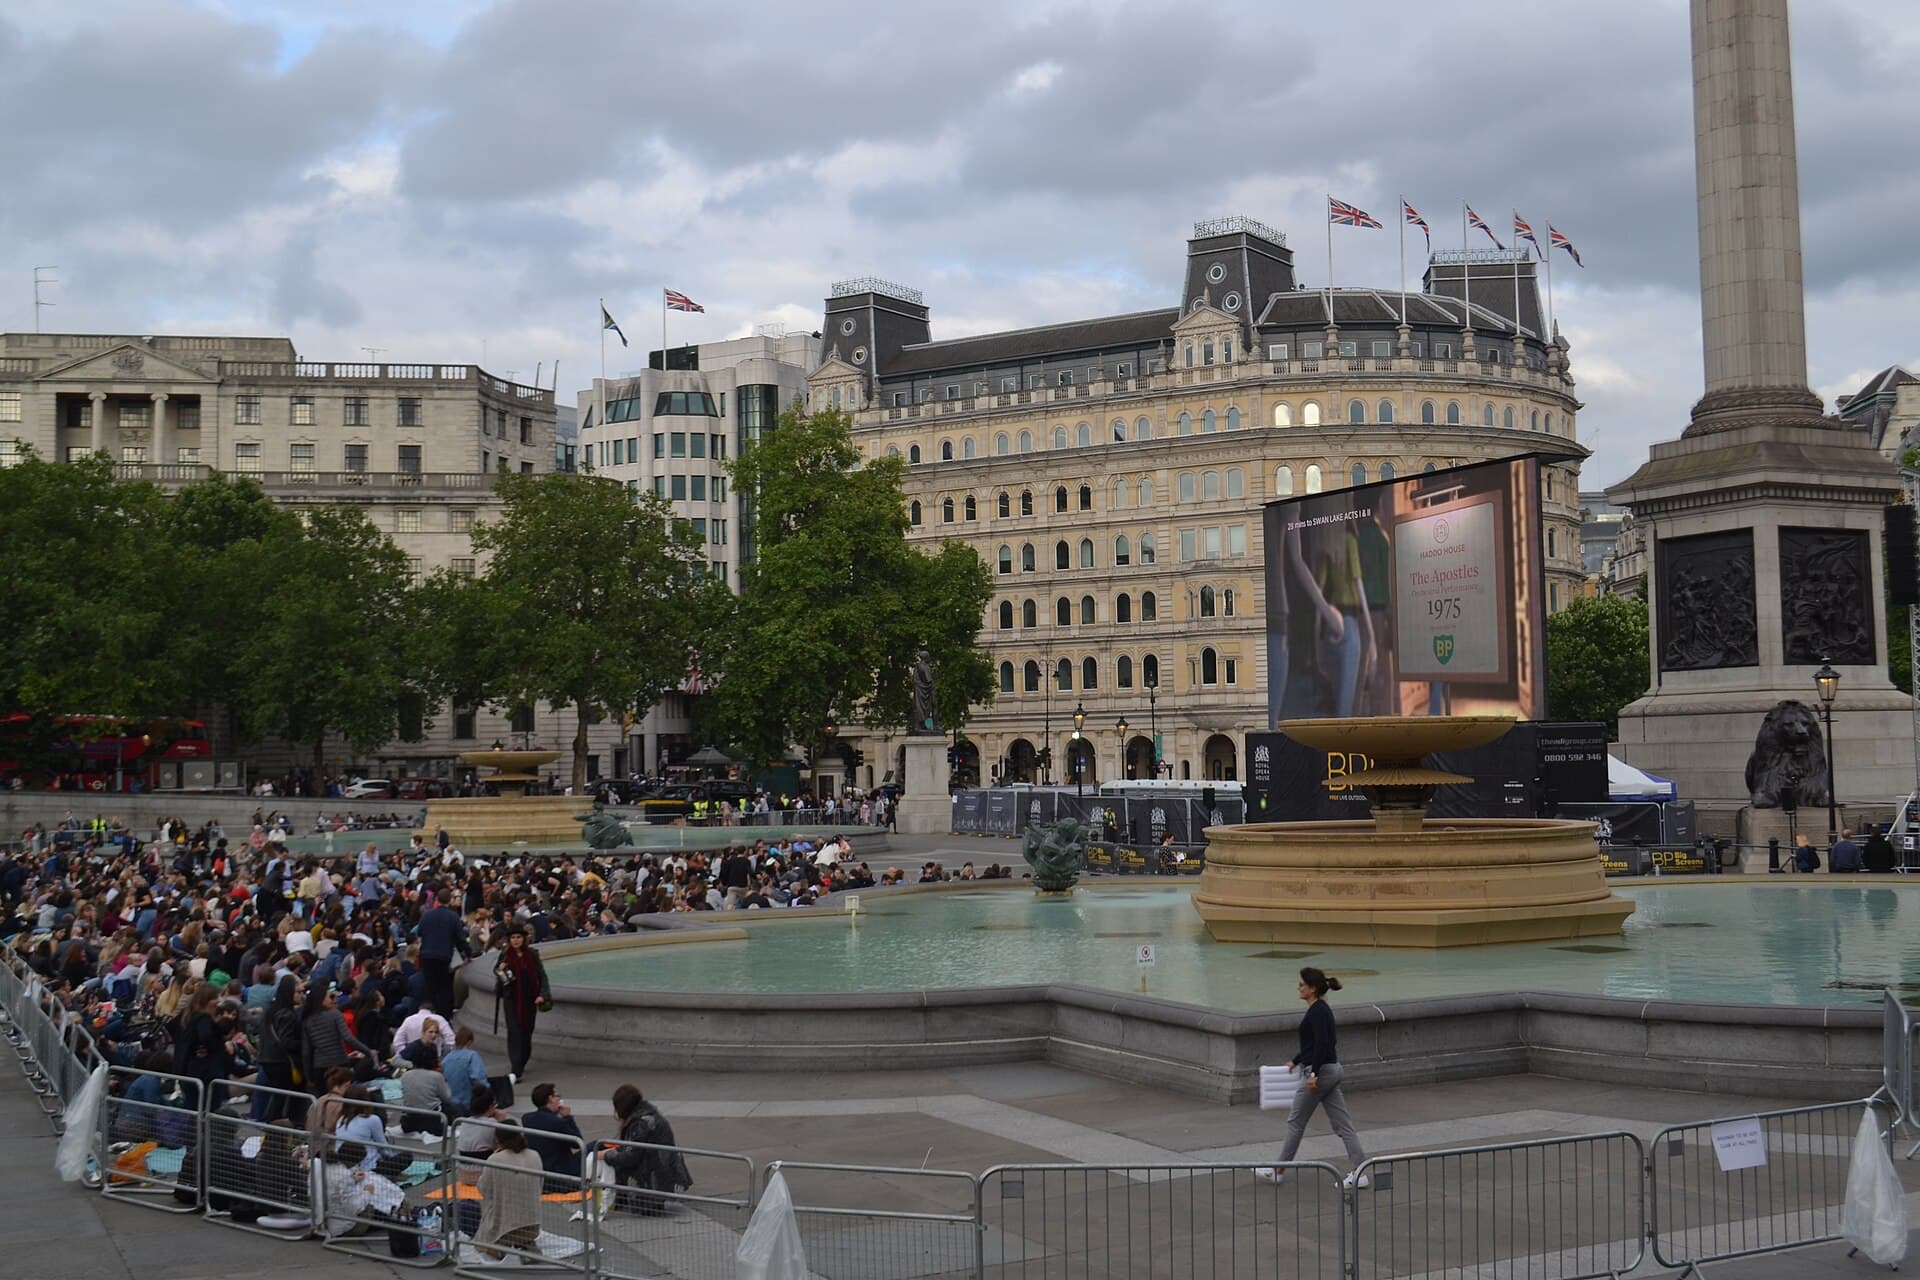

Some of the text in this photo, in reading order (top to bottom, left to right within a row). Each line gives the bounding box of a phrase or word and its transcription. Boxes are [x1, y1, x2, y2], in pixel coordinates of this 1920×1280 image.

[1294, 520, 1306, 529] mins
[1306, 519, 1313, 527] to
[1312, 515, 1330, 526] SWAN
[1329, 513, 1344, 523] LAKE
[1344, 510, 1359, 521] ACTS
[1443, 544, 1465, 556] HOUSE
[1409, 564, 1479, 586] The Apostles
[1427, 597, 1462, 620] 1975
[1437, 639, 1453, 657] BP
[1544, 753, 1602, 762] 0800 592 346
[1651, 851, 1688, 866] BP Big
